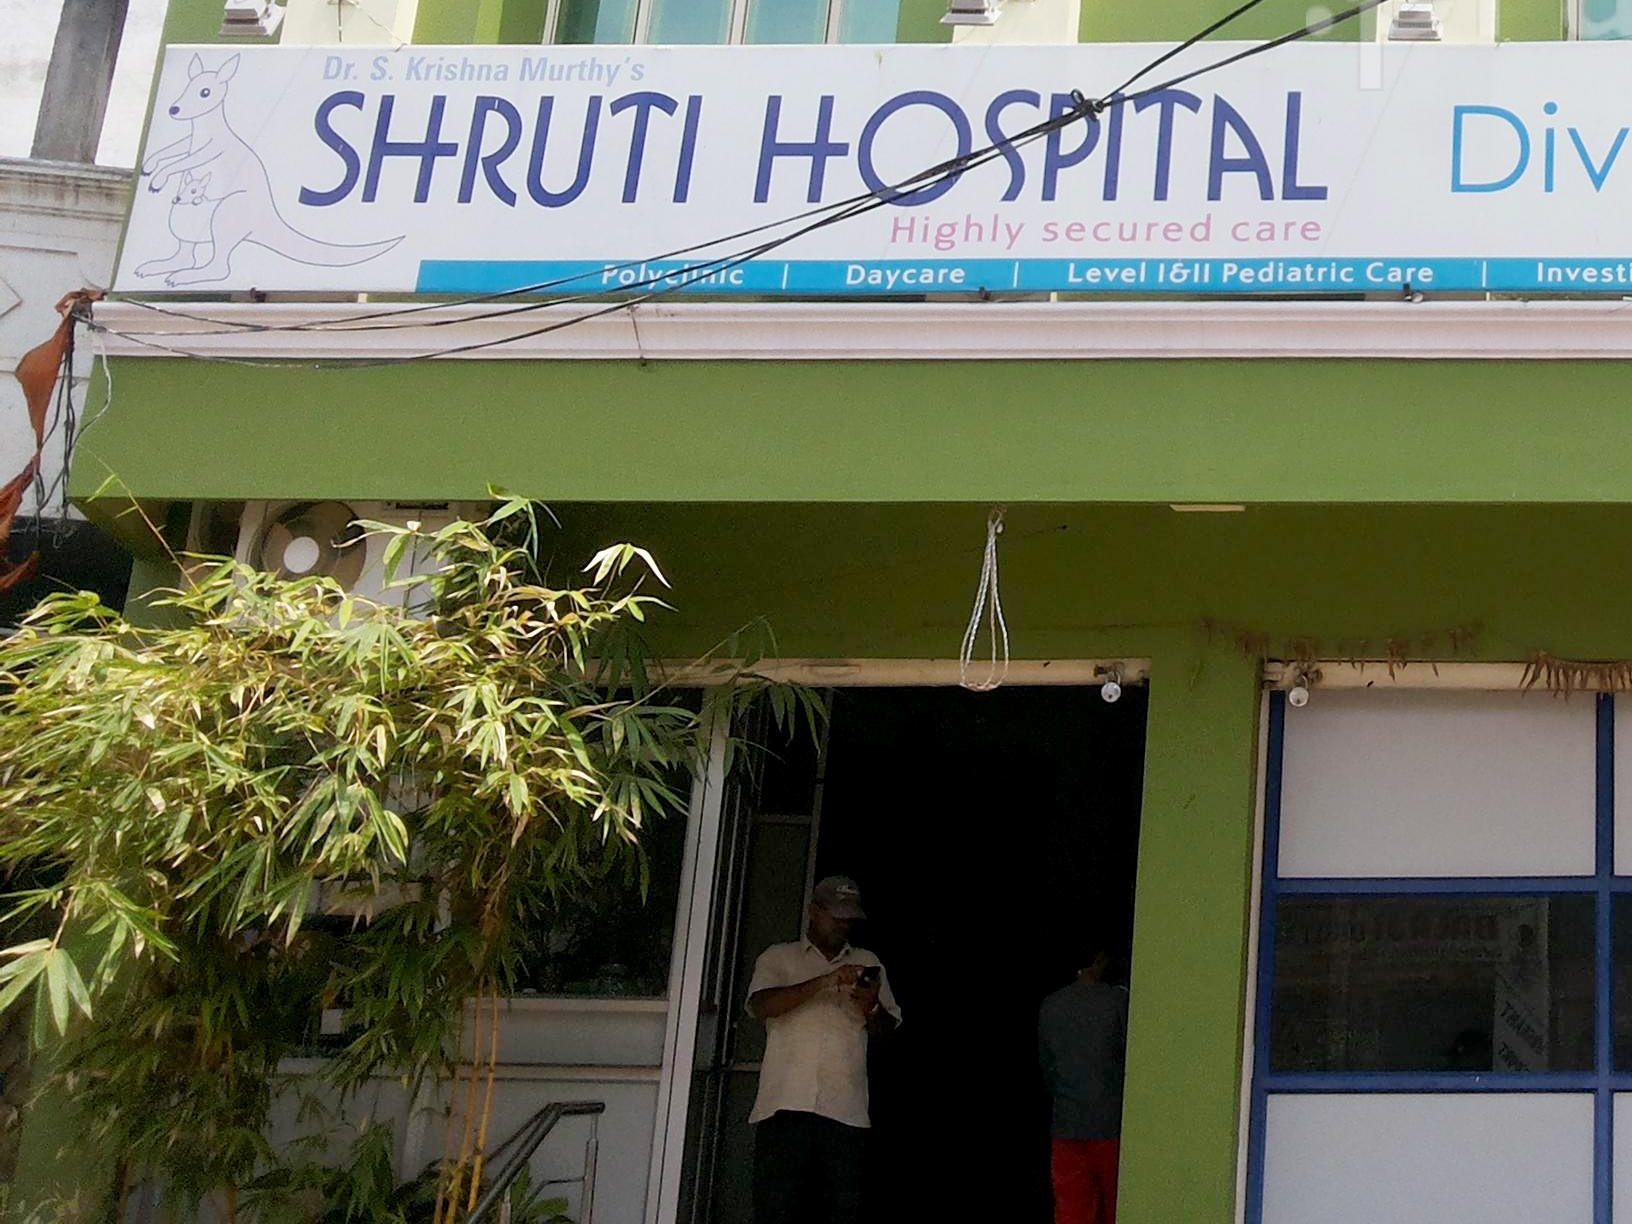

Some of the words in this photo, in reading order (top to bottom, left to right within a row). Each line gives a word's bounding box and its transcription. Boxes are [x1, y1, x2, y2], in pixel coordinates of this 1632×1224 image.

[322, 55, 358, 81] Dr.
[370, 56, 394, 81] S.
[405, 56, 509, 82] Krishna
[519, 56, 645, 87] Murthy's
[298, 90, 703, 208] SHRUTI
[752, 88, 1329, 208] HOSPITAL
[889, 213, 1026, 250] Highly
[1041, 213, 1212, 244] secured
[1230, 220, 1322, 243] care
[601, 262, 745, 290] Polyclinic
[845, 263, 967, 290] Daycare
[1067, 261, 1147, 284] Level
[1221, 261, 1355, 284] Pediatric
[1365, 261, 1434, 283] Care
